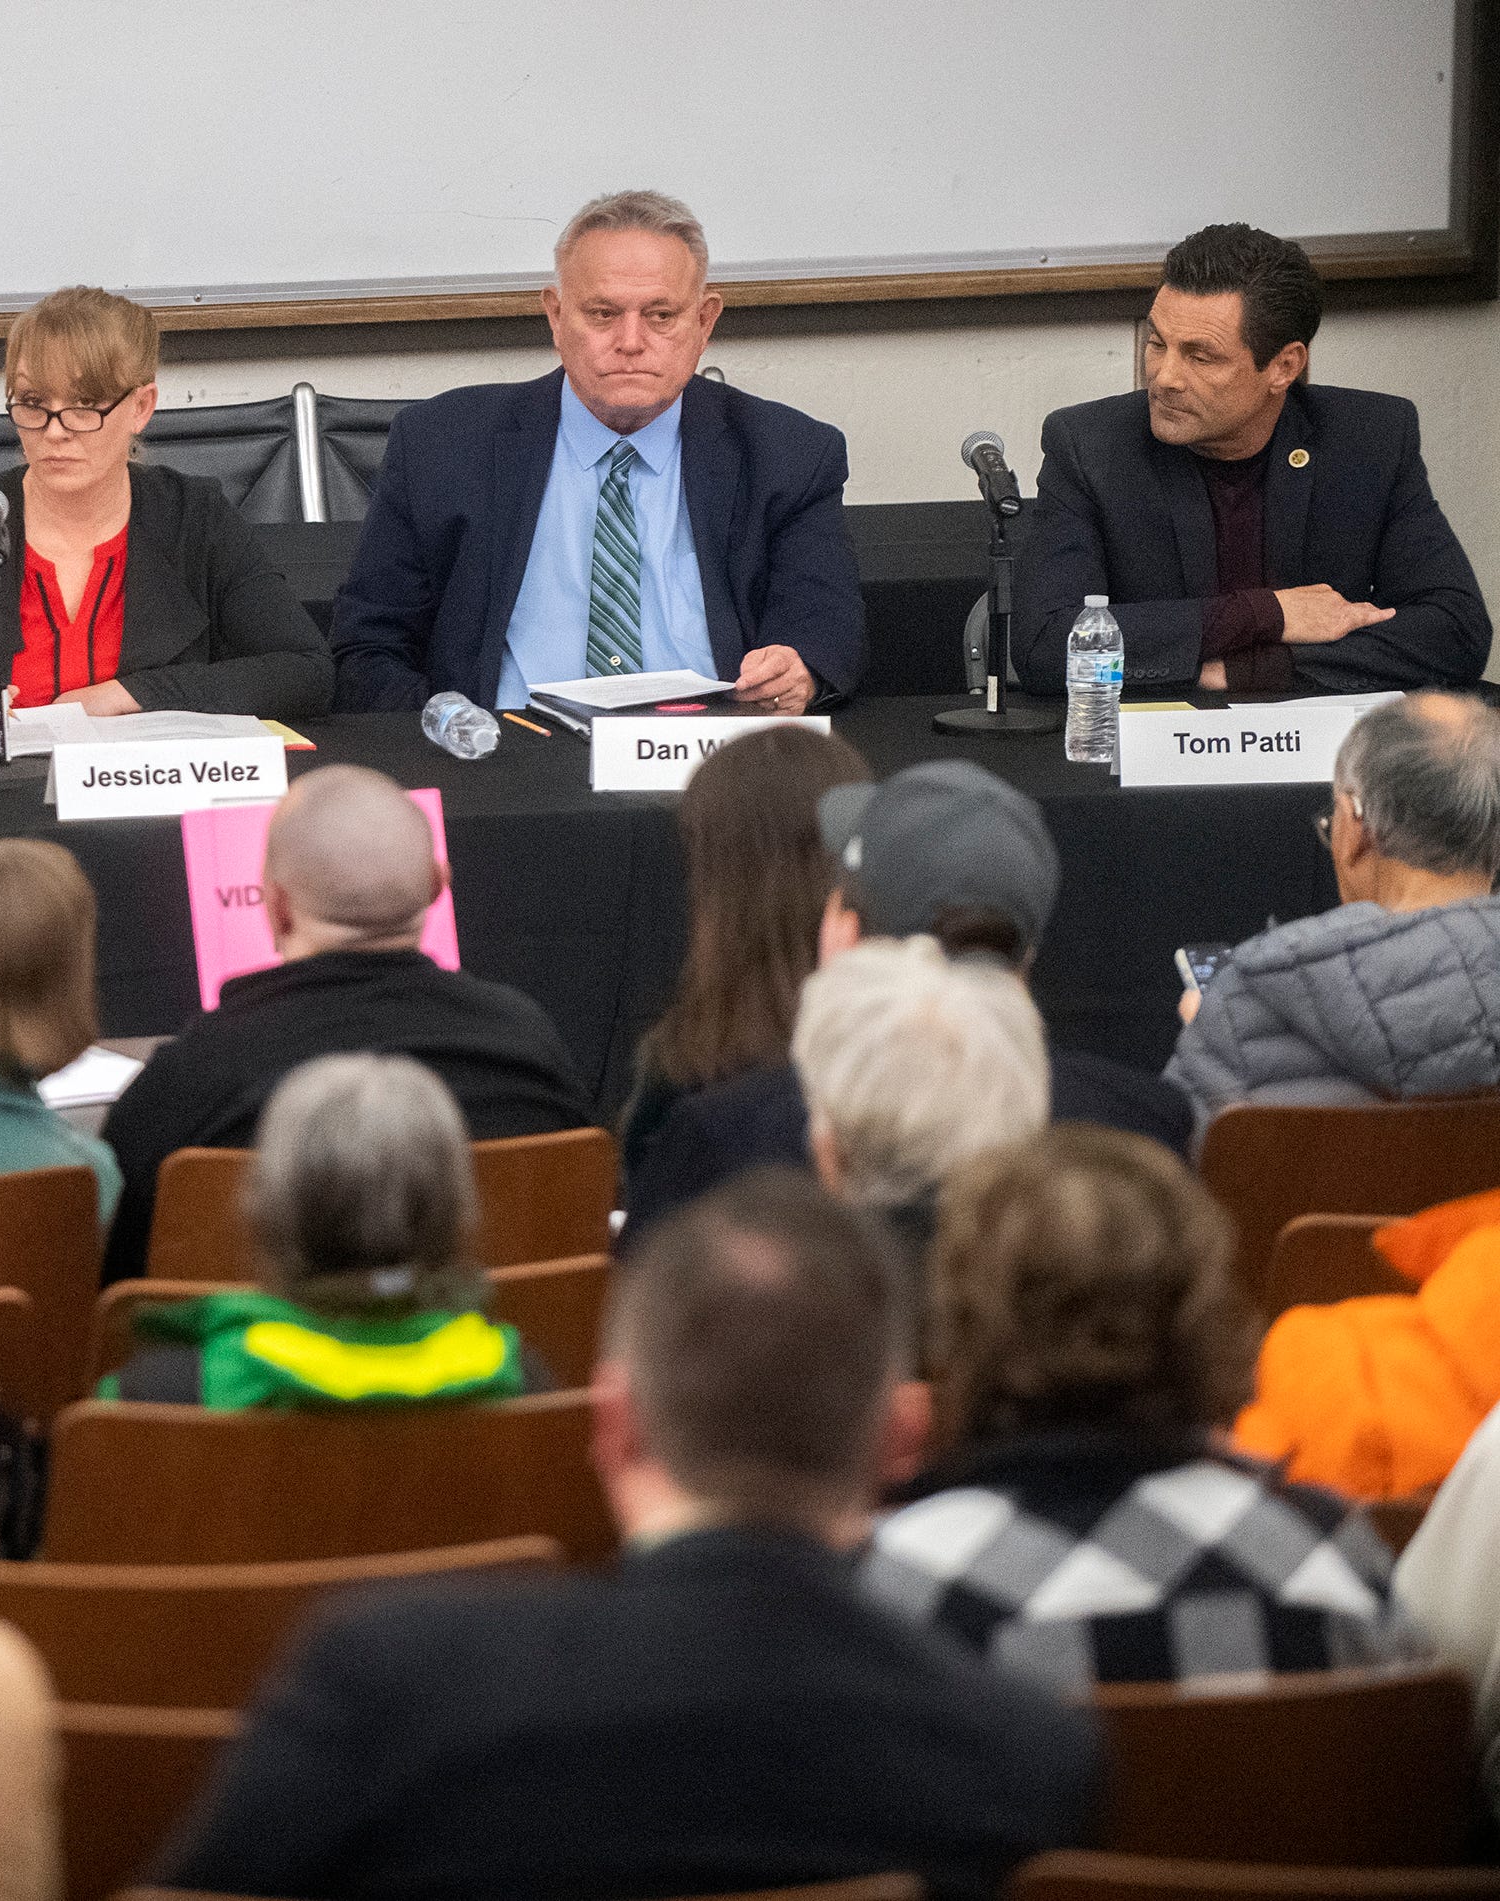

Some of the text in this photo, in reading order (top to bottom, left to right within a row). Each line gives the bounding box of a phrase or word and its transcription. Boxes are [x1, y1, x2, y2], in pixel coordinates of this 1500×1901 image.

[637, 738, 689, 760] Dan
[1173, 730, 1301, 754] Tom Patti
[82, 760, 260, 788] Jessica Velez
[216, 884, 265, 908] VID
